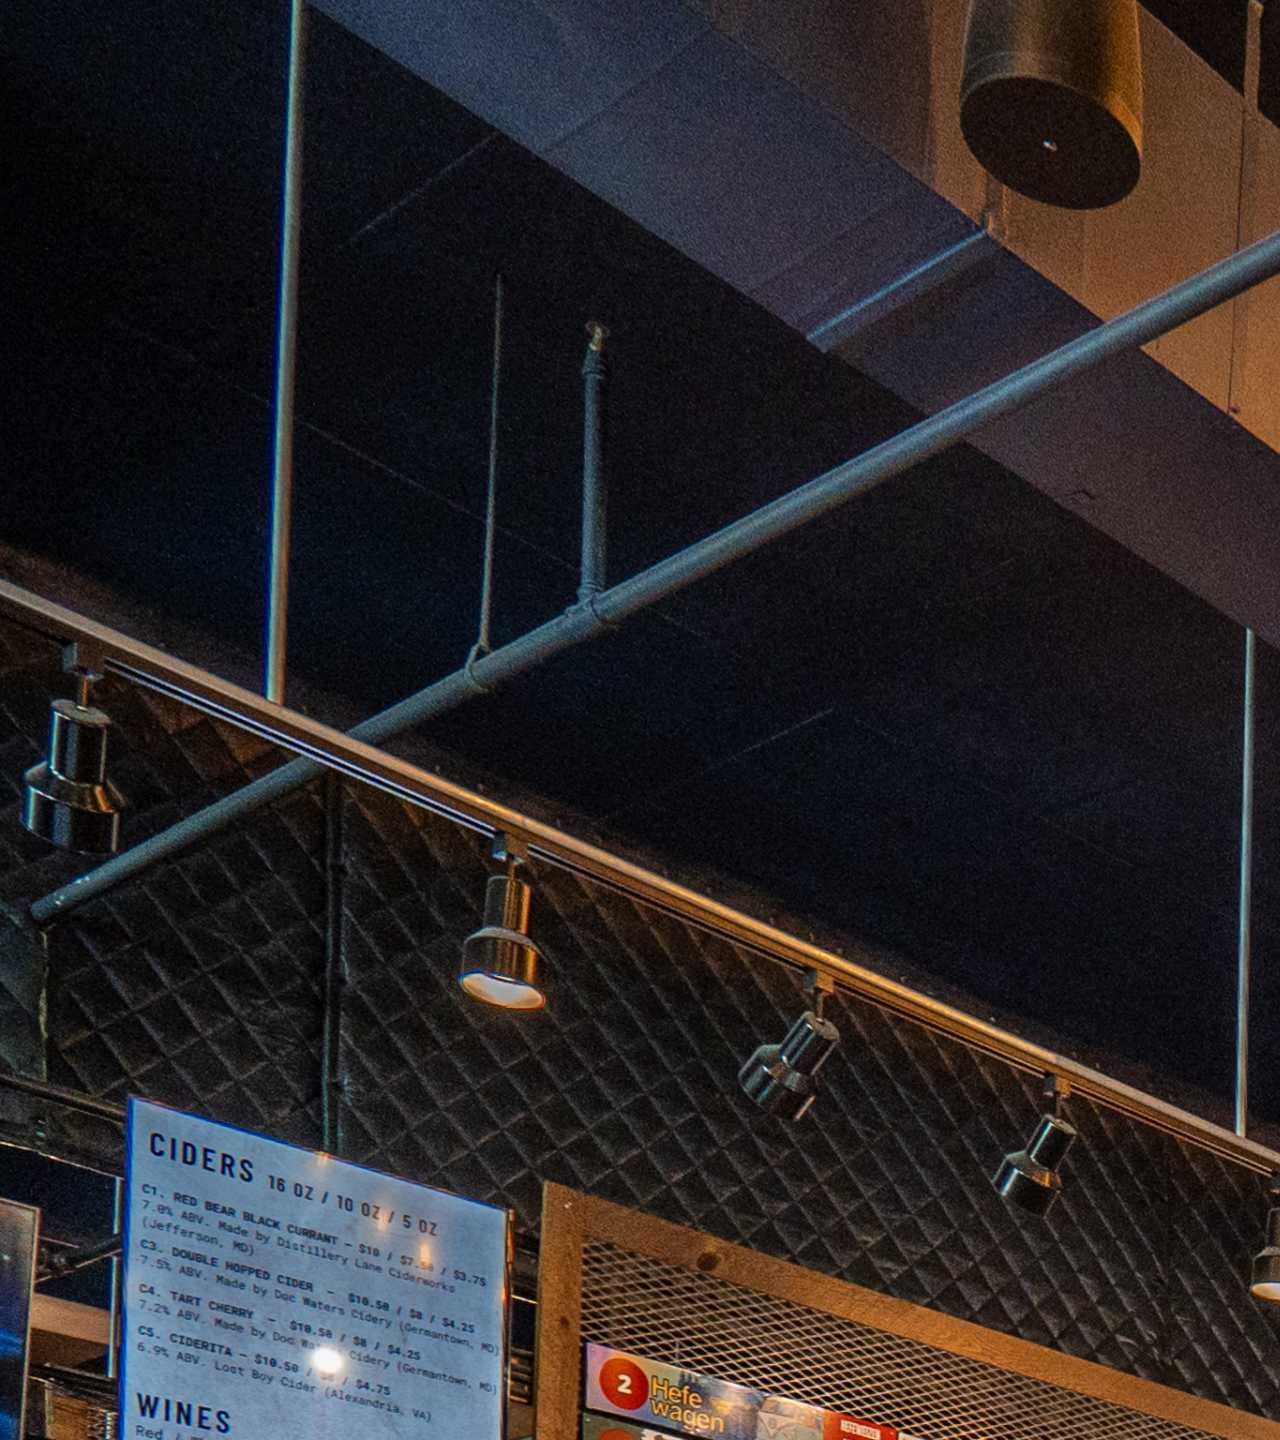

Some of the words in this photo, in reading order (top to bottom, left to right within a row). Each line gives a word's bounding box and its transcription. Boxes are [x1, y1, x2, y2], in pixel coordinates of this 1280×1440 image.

[150, 1132, 254, 1182] CIDERS
[267, 1174, 285, 1192] 16
[293, 1183, 315, 1201] OZ
[336, 1195, 354, 1212] 10
[361, 1202, 381, 1220] OZ
[402, 1214, 412, 1229] 5
[418, 1219, 438, 1236] OZ
[173, 1192, 198, 1207] RED
[205, 1200, 237, 1219] BEAR
[243, 1211, 281, 1231] BLACK
[287, 1223, 339, 1246] CURRANT
[255, 1231, 271, 1246] by
[171, 1247, 219, 1268] DOUBLE
[225, 1261, 271, 1281] HOPPED
[276, 1274, 314, 1292] CIDER
[169, 1290, 203, 1307] TART
[208, 1300, 254, 1320] CHERRY
[252, 1283, 268, 1298] by
[169, 1332, 233, 1357] CIDERITA
[616, 1374, 633, 1395] 2
[651, 1375, 703, 1409] Hefe
[136, 1392, 232, 1434] WINES
[651, 1399, 725, 1434] wagen
[135, 1424, 164, 1440] Red
